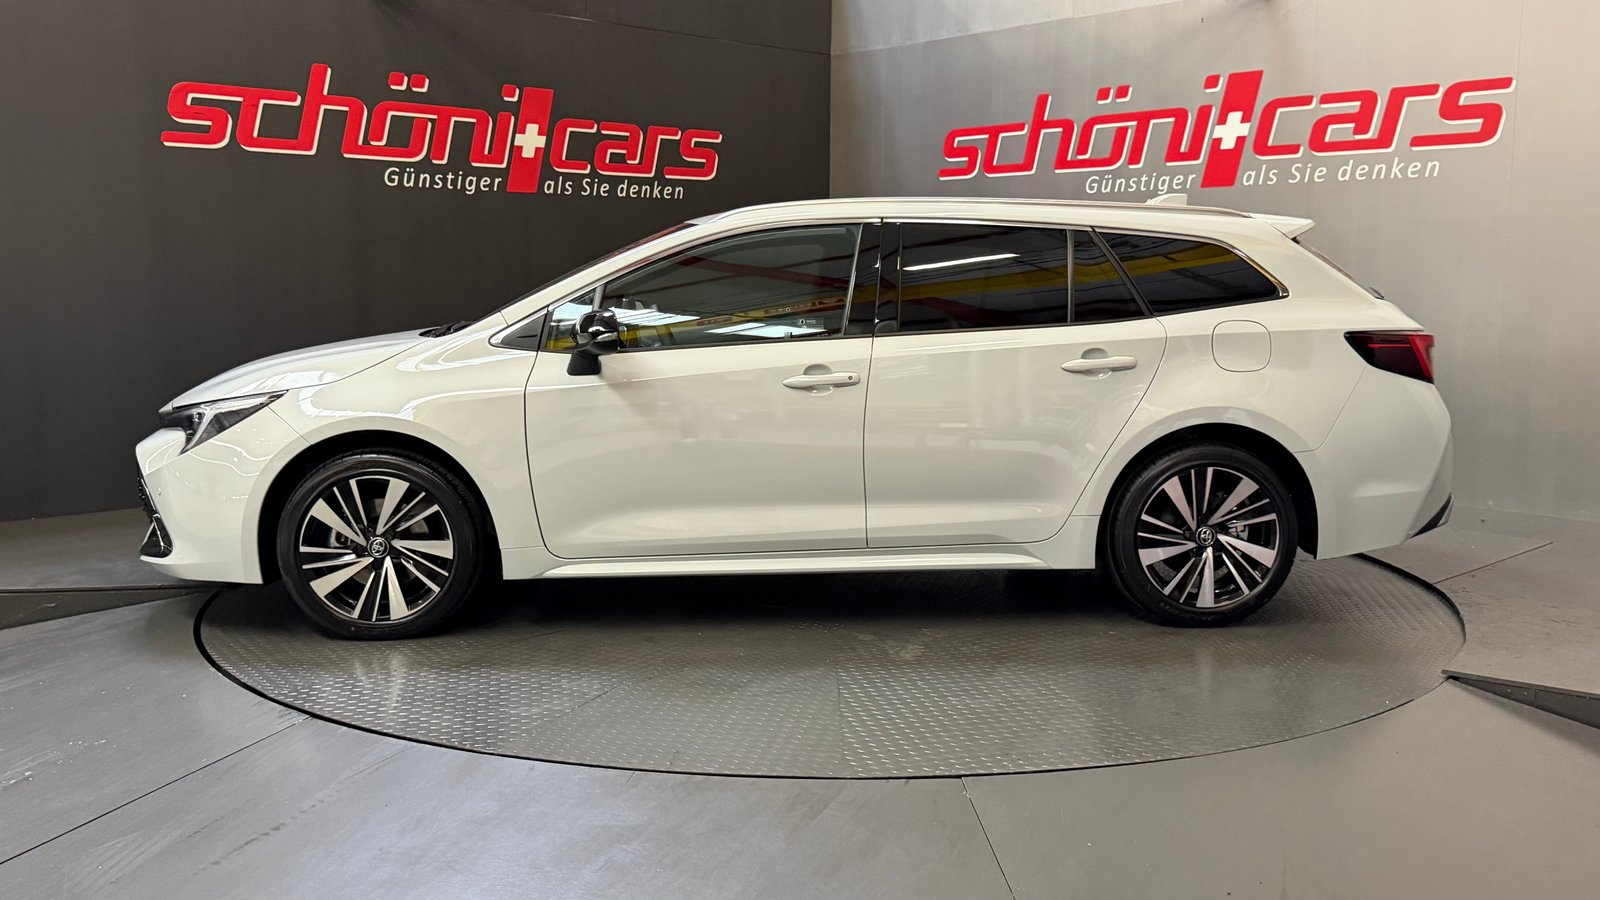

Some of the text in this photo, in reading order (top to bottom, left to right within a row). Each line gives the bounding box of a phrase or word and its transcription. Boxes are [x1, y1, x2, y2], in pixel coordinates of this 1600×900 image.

[384, 167, 684, 199] Günstiger als Sie denken
[1085, 157, 1441, 194] Günstiger als Sie denken
